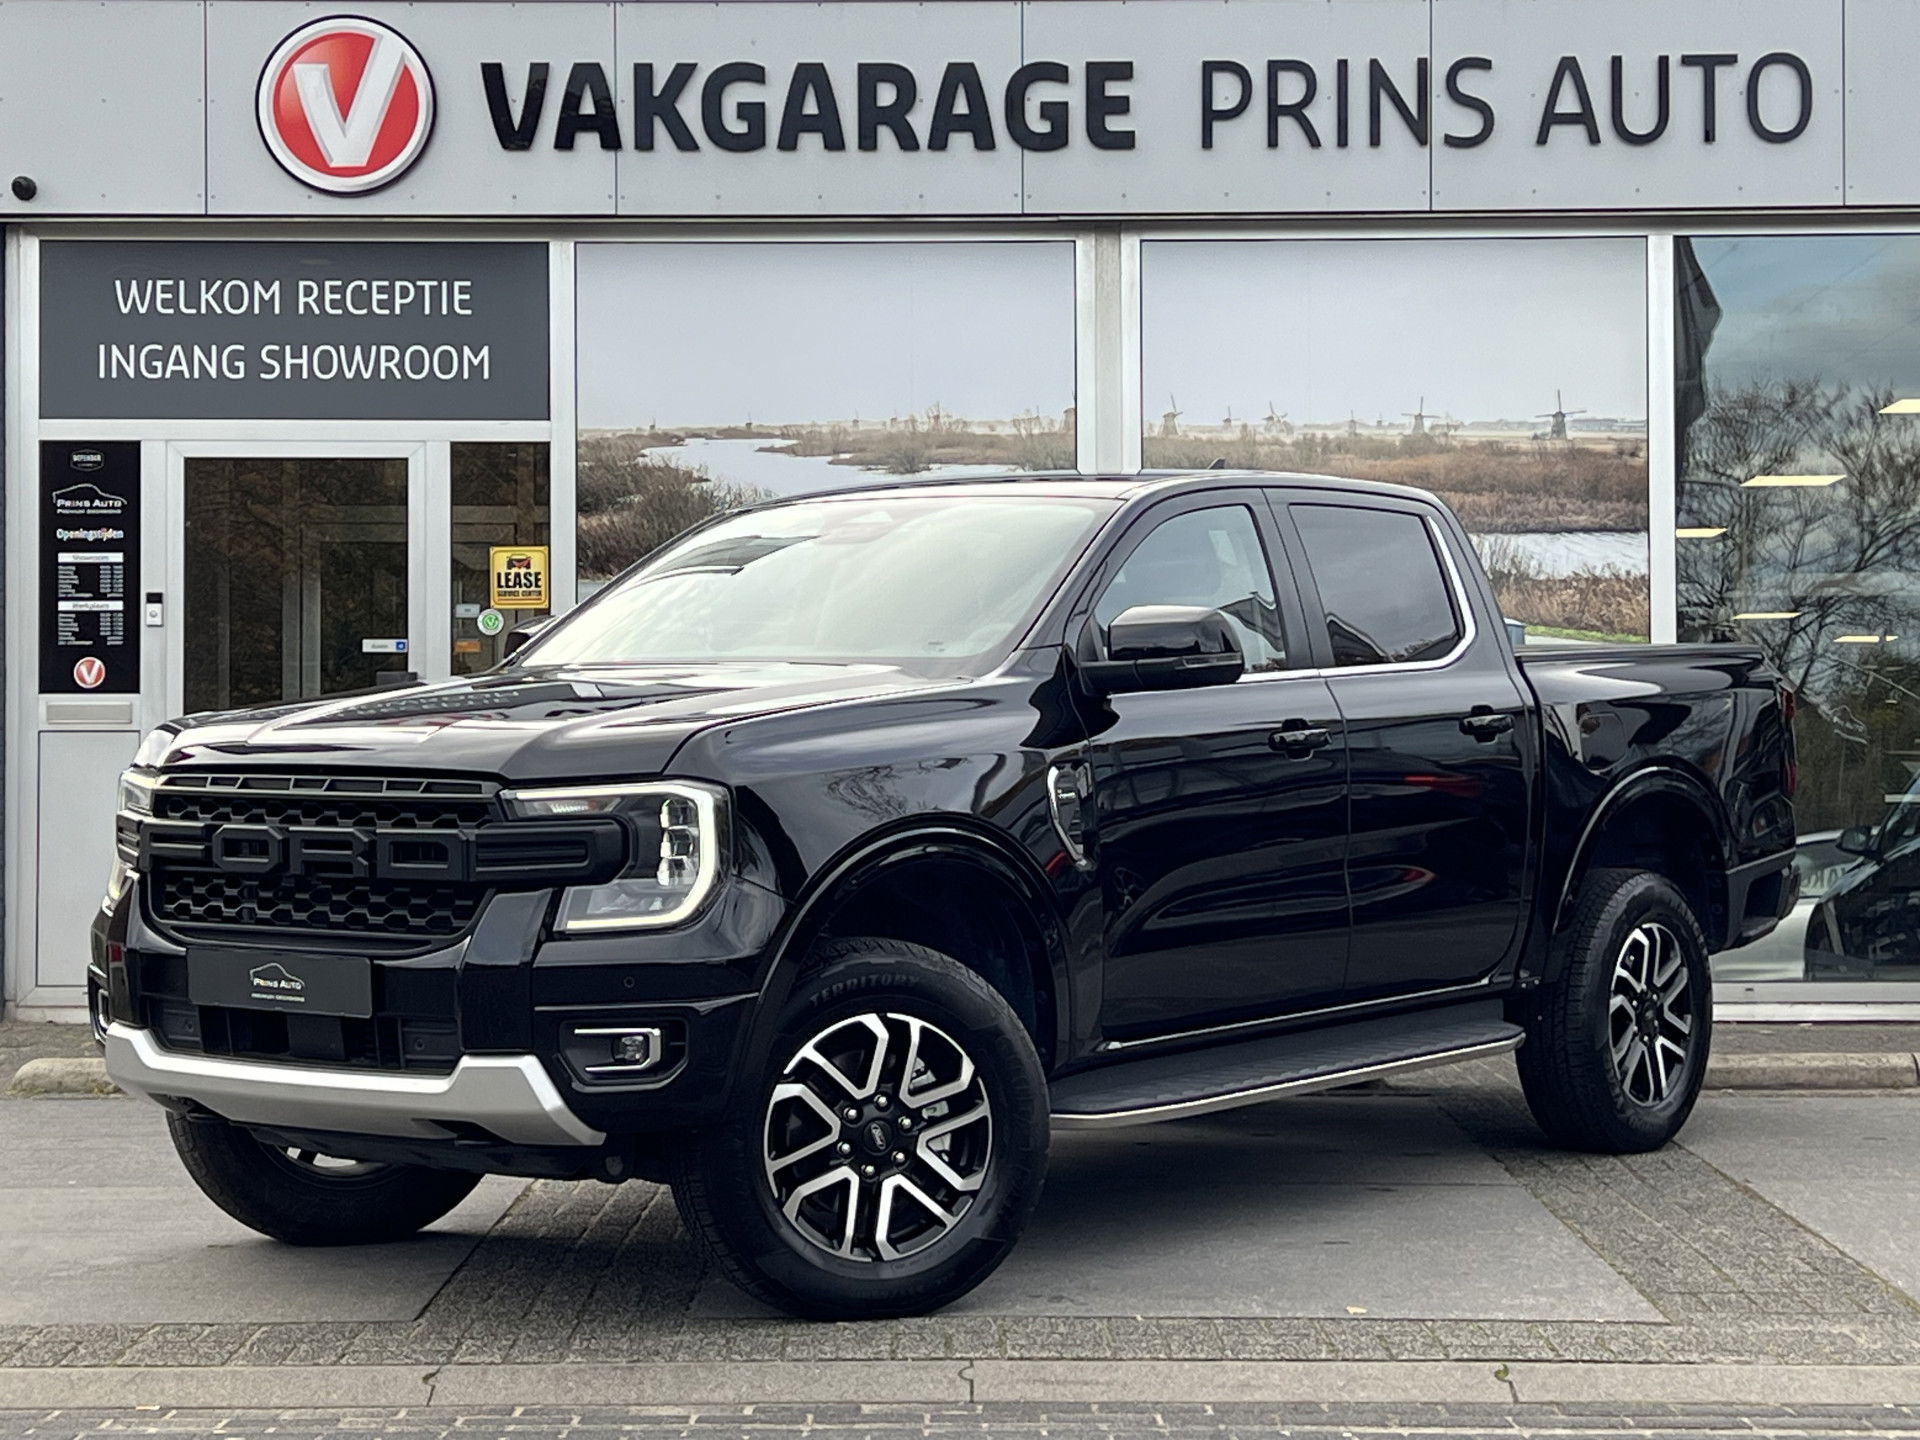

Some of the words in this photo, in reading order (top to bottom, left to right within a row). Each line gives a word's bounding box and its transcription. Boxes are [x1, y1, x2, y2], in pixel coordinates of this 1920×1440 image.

[480, 61, 1137, 153] VAKGARAGE
[1201, 56, 1496, 149] PRINS
[1536, 52, 1813, 147] AUTO
[115, 279, 281, 315] WELKOM
[299, 280, 473, 315] RECEPTIE
[98, 343, 246, 380] INGANG
[259, 344, 491, 381] SHOWROOM
[496, 572, 542, 588] LEASE
[139, 823, 468, 882] FORD
[808, 973, 920, 1007] TERRITORY
